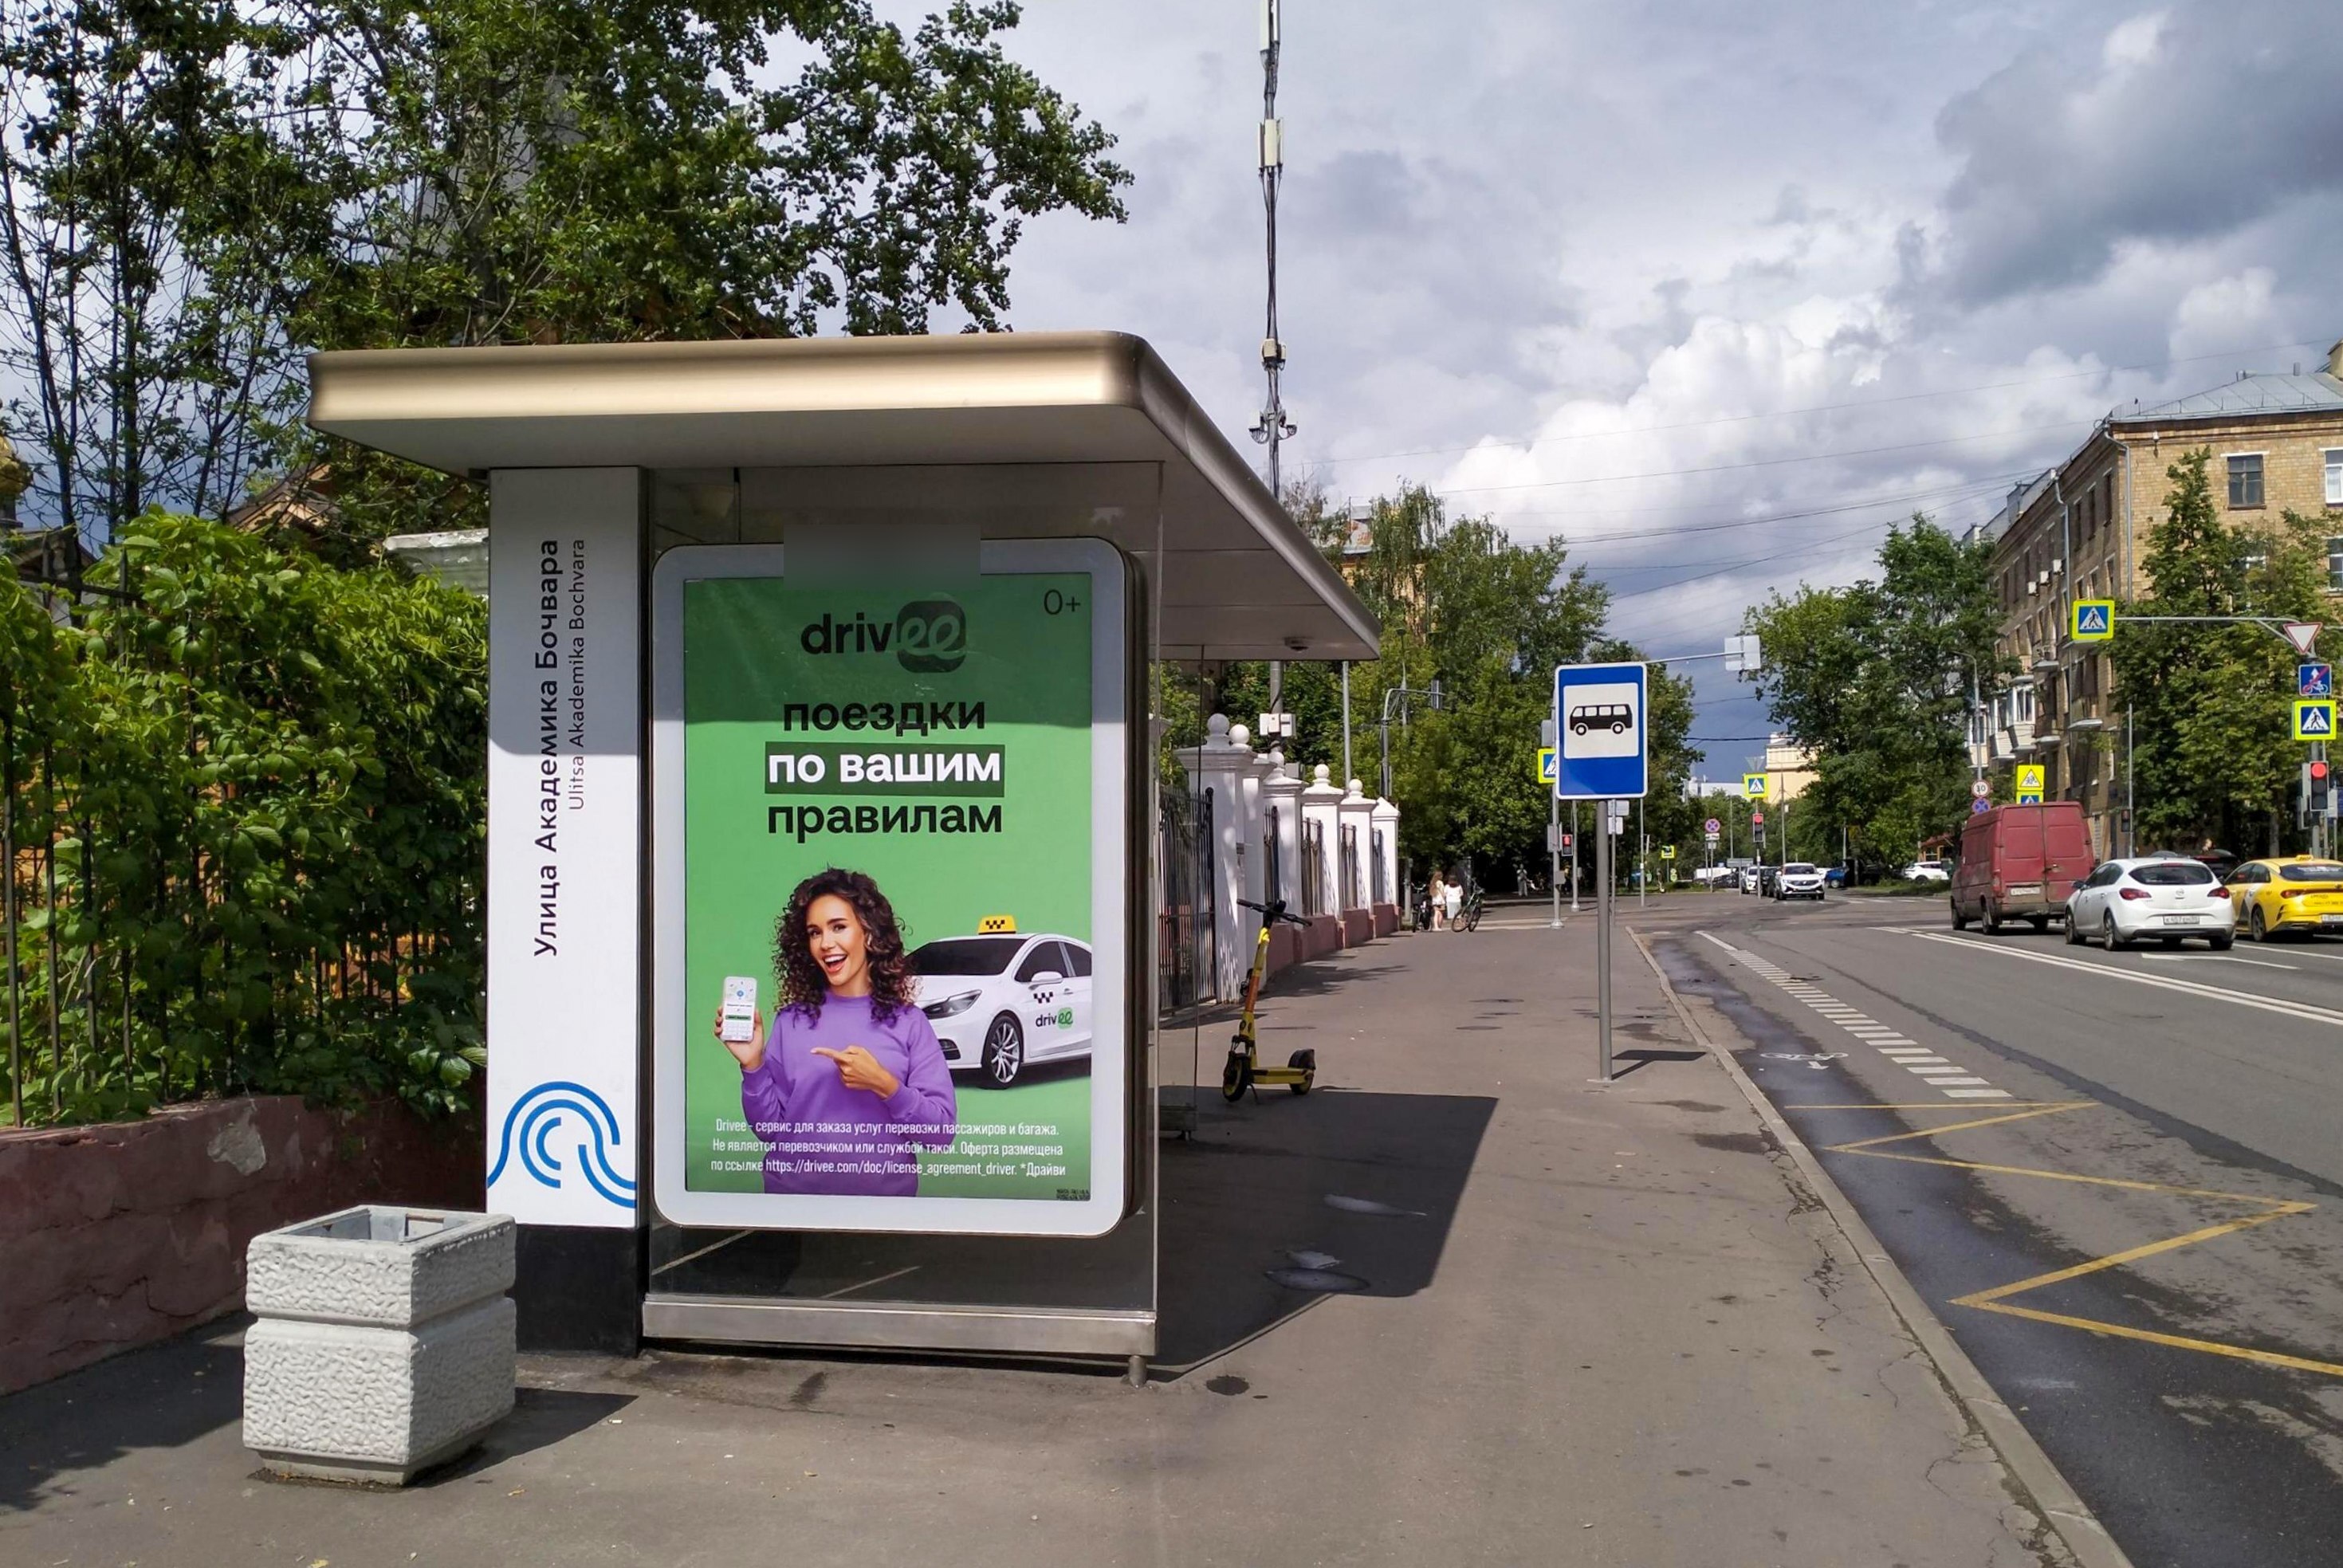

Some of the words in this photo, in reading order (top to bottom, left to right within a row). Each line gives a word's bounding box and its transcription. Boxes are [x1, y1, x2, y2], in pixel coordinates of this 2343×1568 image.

[535, 540, 564, 669] Бочвара
[568, 539, 584, 630] Bochvara
[1043, 589, 1081, 615] 0+
[800, 612, 967, 660] drivee
[568, 637, 584, 748] Akademika
[784, 701, 985, 737] поездки
[534, 680, 561, 852] Академика
[568, 756, 584, 809] Ulitsa
[769, 753, 826, 784] по
[839, 753, 1000, 784] вашим
[768, 804, 1002, 844] правилам
[534, 866, 560, 956] Улица
[1036, 1011, 1073, 1027] drivee
[713, 1138, 725, 1151] Не
[728, 1141, 776, 1152] является
[778, 1142, 853, 1154] перевозчиком
[855, 1142, 875, 1153] или
[877, 1141, 923, 1156] службой
[926, 1143, 958, 1154] такси.
[961, 1141, 999, 1156] Оферта
[1001, 1144, 1063, 1157] размещена
[716, 1118, 746, 1132] Drivee
[755, 1122, 792, 1135] сервис
[793, 1122, 813, 1134] для
[816, 1122, 851, 1134] заказа
[854, 1123, 883, 1136] услуг
[886, 1123, 940, 1136] перевозки
[942, 1123, 1006, 1137] пассажиров
[1009, 1125, 1016, 1134] и
[1018, 1122, 1059, 1136] багажа.
[711, 1161, 723, 1171] по
[725, 1161, 764, 1171] ссылке
